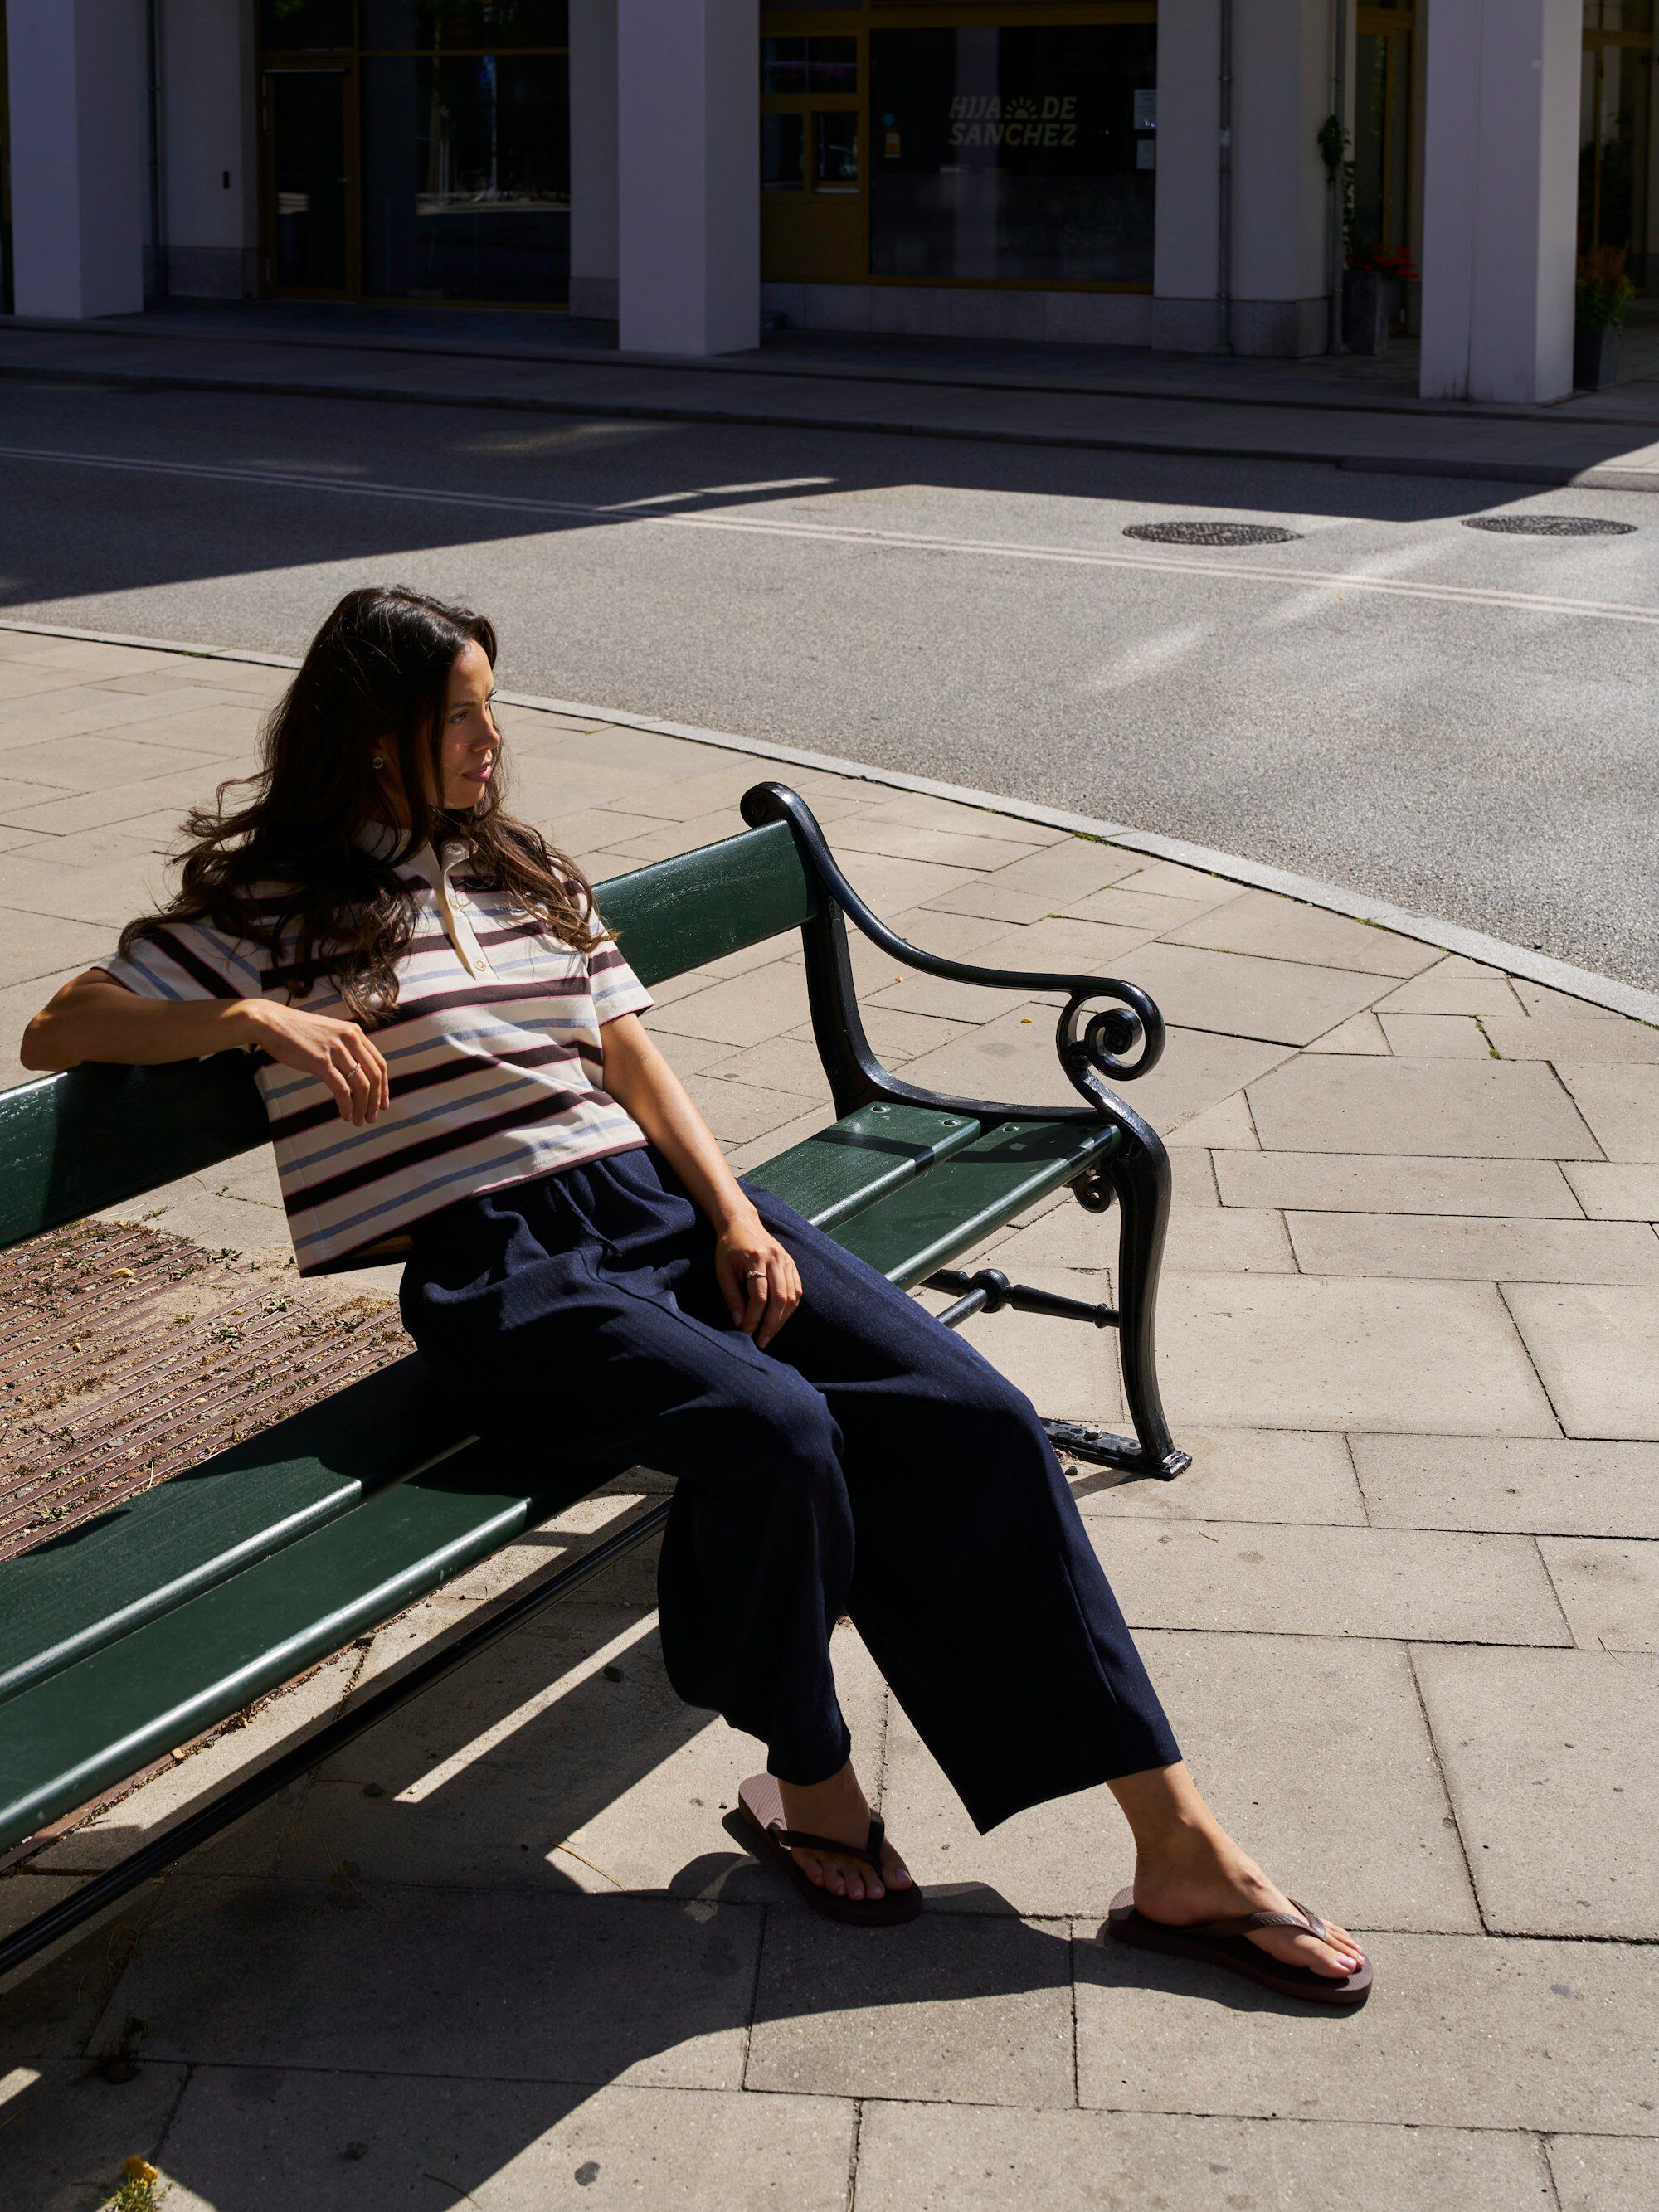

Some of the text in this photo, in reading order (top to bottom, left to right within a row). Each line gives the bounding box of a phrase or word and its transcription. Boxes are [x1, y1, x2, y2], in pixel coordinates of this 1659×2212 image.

[949, 97, 1078, 119] HIJA DE
[949, 124, 1078, 146] SANCHEZ
